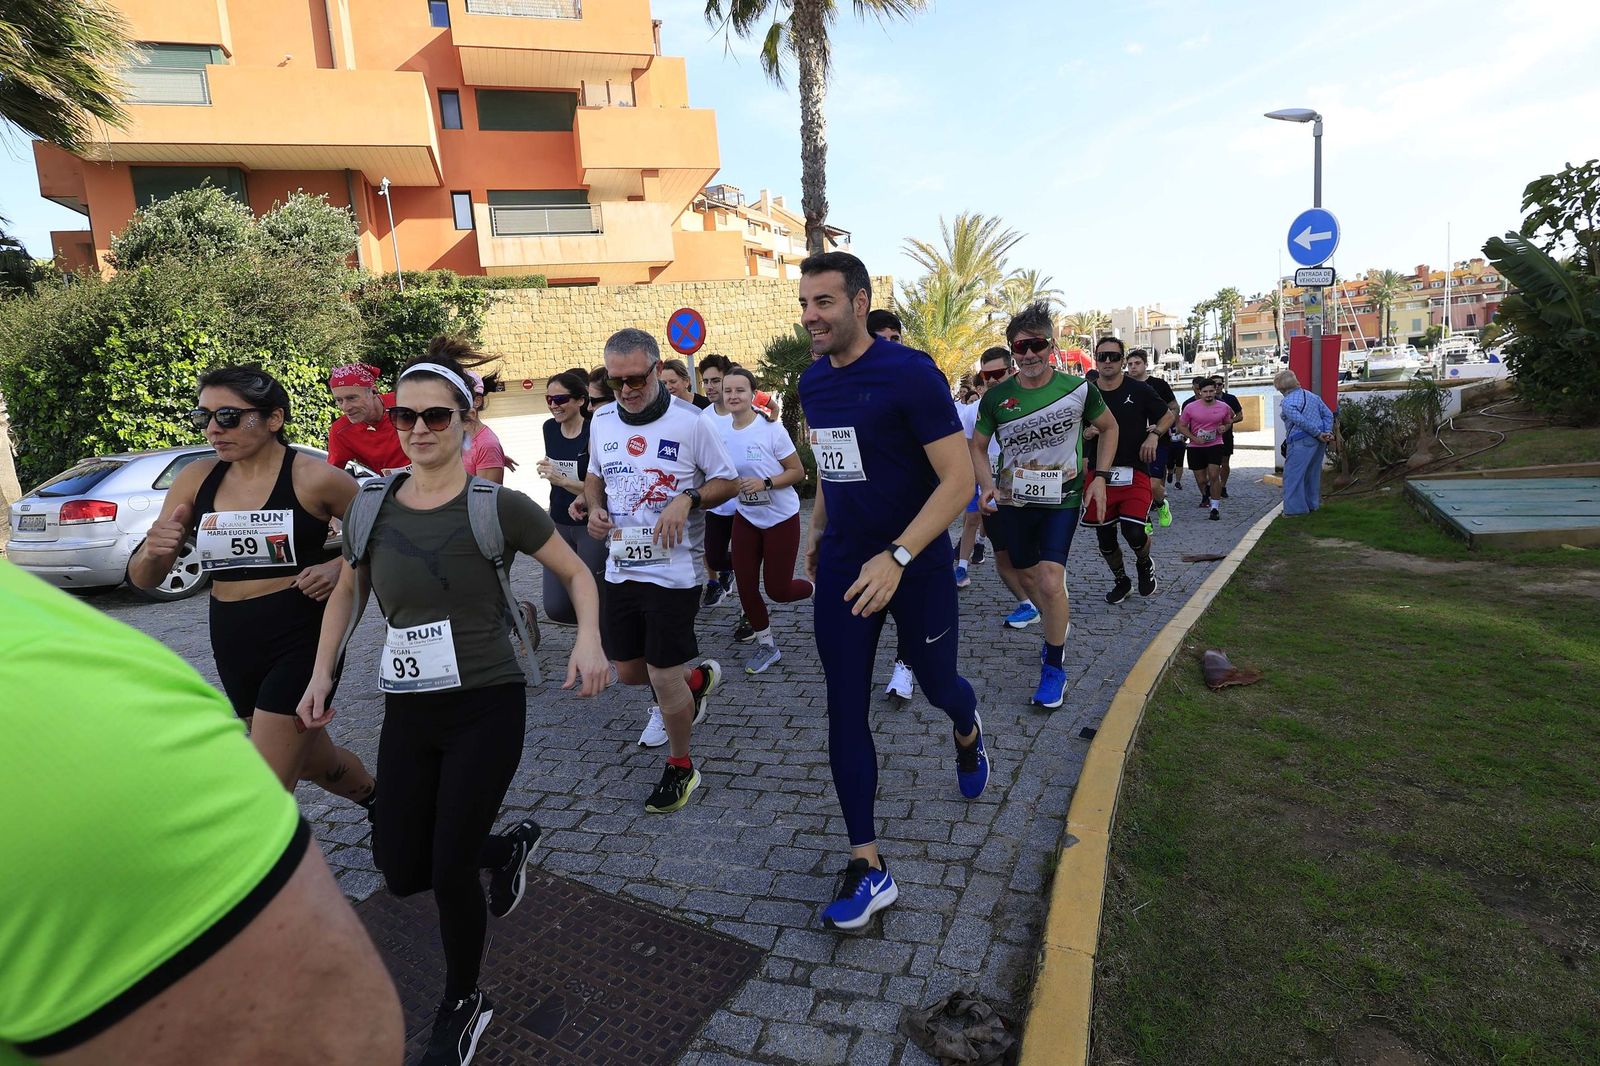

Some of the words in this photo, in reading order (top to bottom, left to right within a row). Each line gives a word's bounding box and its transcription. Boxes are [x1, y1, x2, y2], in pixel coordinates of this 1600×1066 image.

[832, 430, 851, 439] RUN
[658, 446, 677, 457] AXA
[822, 451, 845, 469] 212
[1024, 483, 1046, 496] 281
[234, 513, 248, 521] The
[250, 512, 284, 523] RUN
[231, 537, 258, 556] 59
[625, 545, 653, 560] 215
[406, 625, 443, 642] RUN
[389, 648, 411, 656] MEGAN
[392, 656, 420, 679] 93
